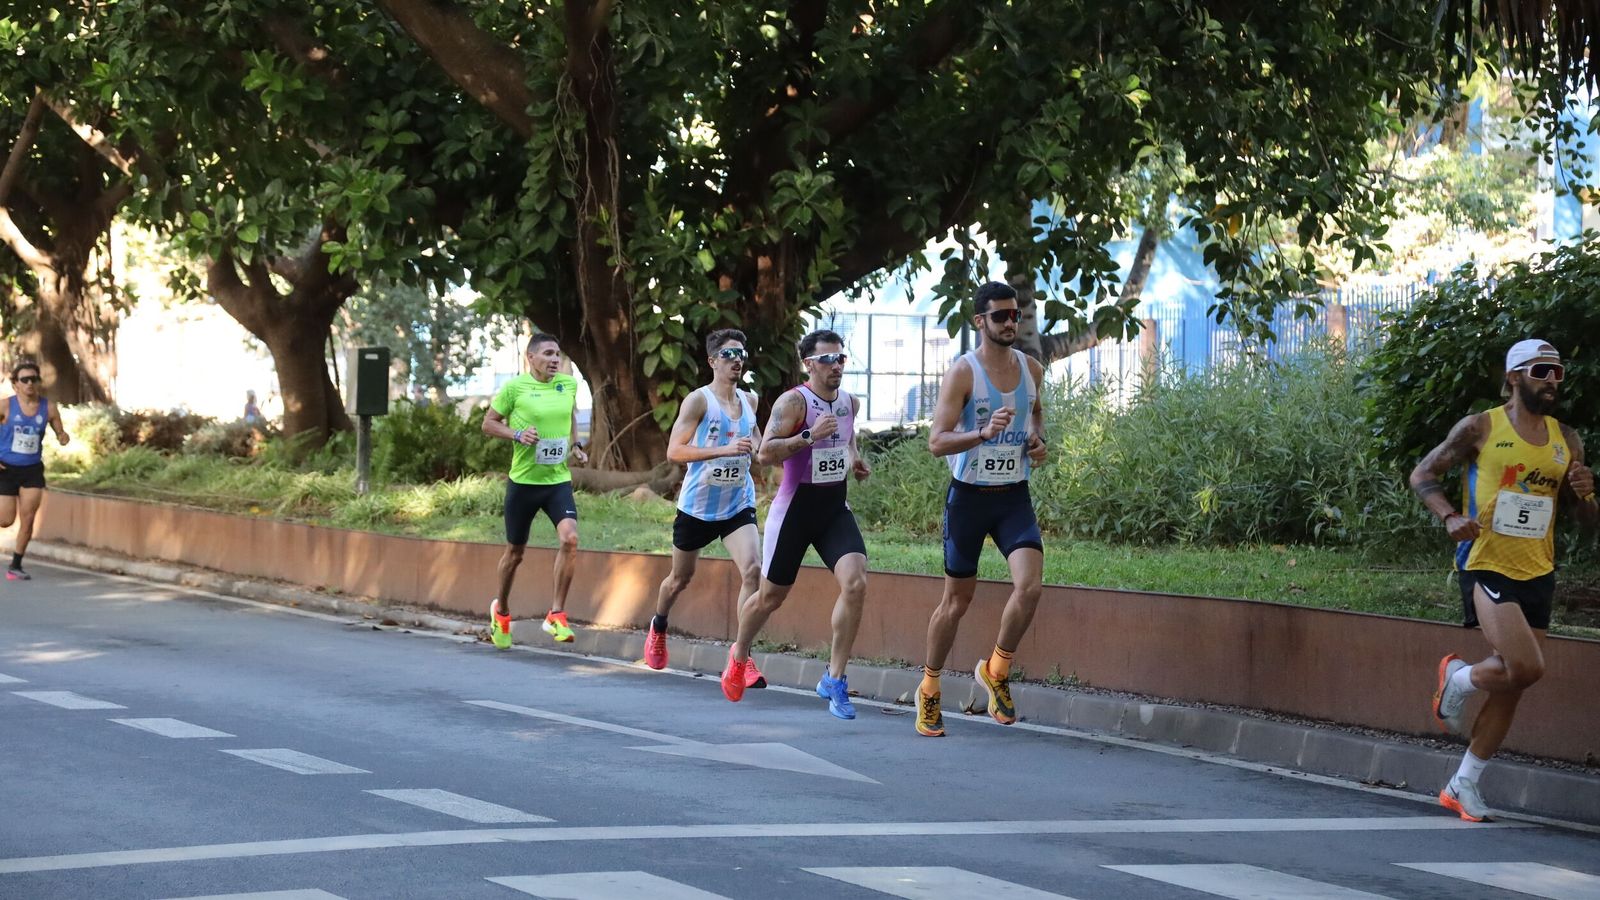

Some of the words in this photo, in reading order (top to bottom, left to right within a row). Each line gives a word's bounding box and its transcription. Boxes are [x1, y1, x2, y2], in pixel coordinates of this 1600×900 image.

[542, 447, 563, 456] 148
[819, 459, 845, 472] 834
[985, 459, 1015, 471] 870
[713, 468, 739, 478] 312
[1517, 509, 1530, 524] 5
